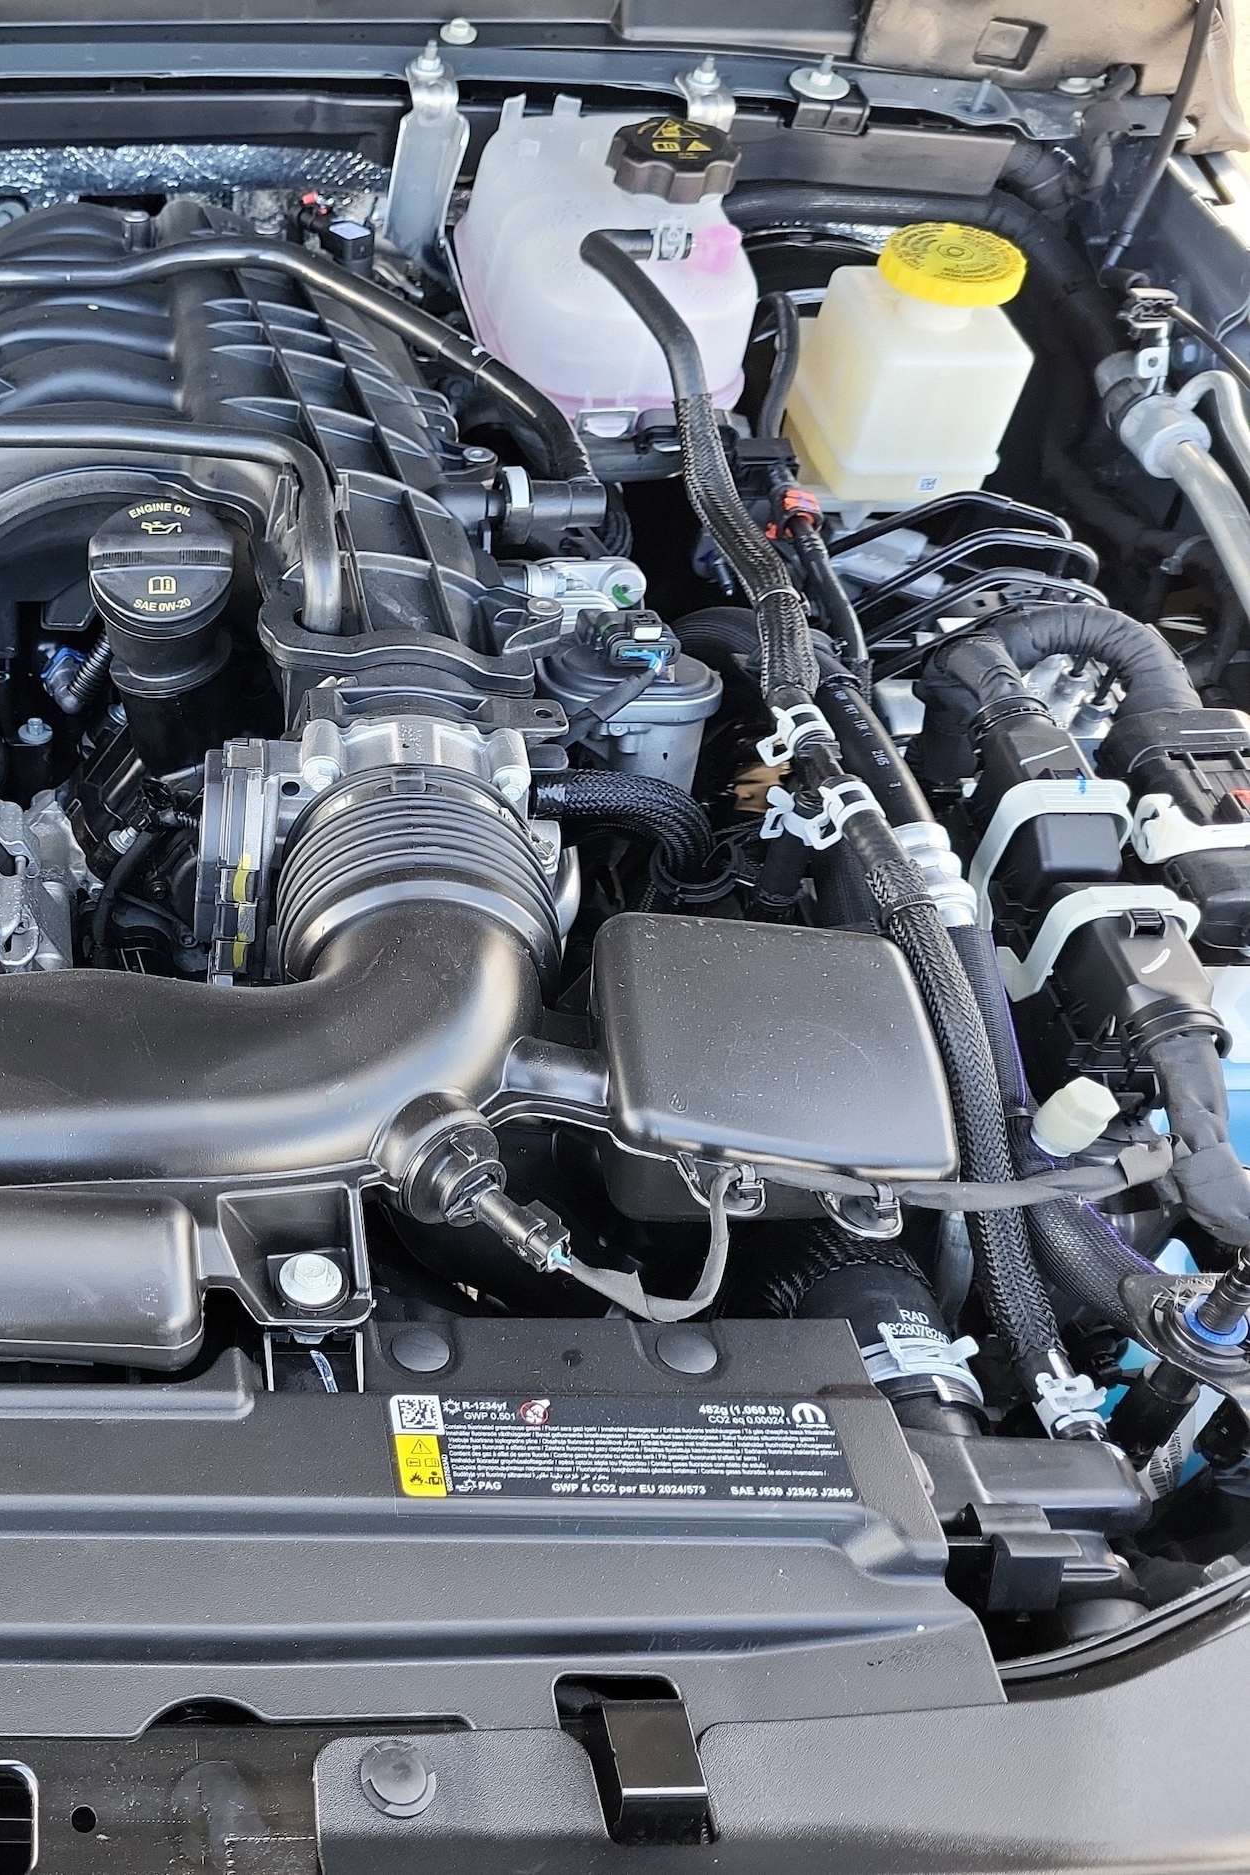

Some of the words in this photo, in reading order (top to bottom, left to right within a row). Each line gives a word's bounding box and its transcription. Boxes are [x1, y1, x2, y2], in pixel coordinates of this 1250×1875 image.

[128, 502, 172, 519] ENGINE
[173, 504, 191, 517] OIL
[133, 598, 157, 612] SAE
[158, 597, 191, 612] 0W-20
[899, 1309, 930, 1325] RAD
[464, 1412, 489, 1421] GWP
[490, 1412, 516, 1421] 0.501
[698, 1405, 729, 1417] 482g
[729, 1405, 766, 1417] (1.060
[768, 1405, 786, 1417] lb)
[708, 1416, 730, 1424] CO2
[732, 1417, 746, 1426] eq
[747, 1416, 784, 1425] 0.00024
[478, 1480, 502, 1490] PAG
[551, 1483, 579, 1493] GWP
[581, 1484, 591, 1493] &
[592, 1484, 617, 1494] CO2
[618, 1487, 637, 1496] per
[638, 1485, 655, 1494] EU
[657, 1484, 707, 1495] 2024/573
[730, 1486, 755, 1496] SAE
[757, 1486, 783, 1496] J639
[785, 1486, 819, 1497] J2842
[820, 1487, 854, 1498] J2845
